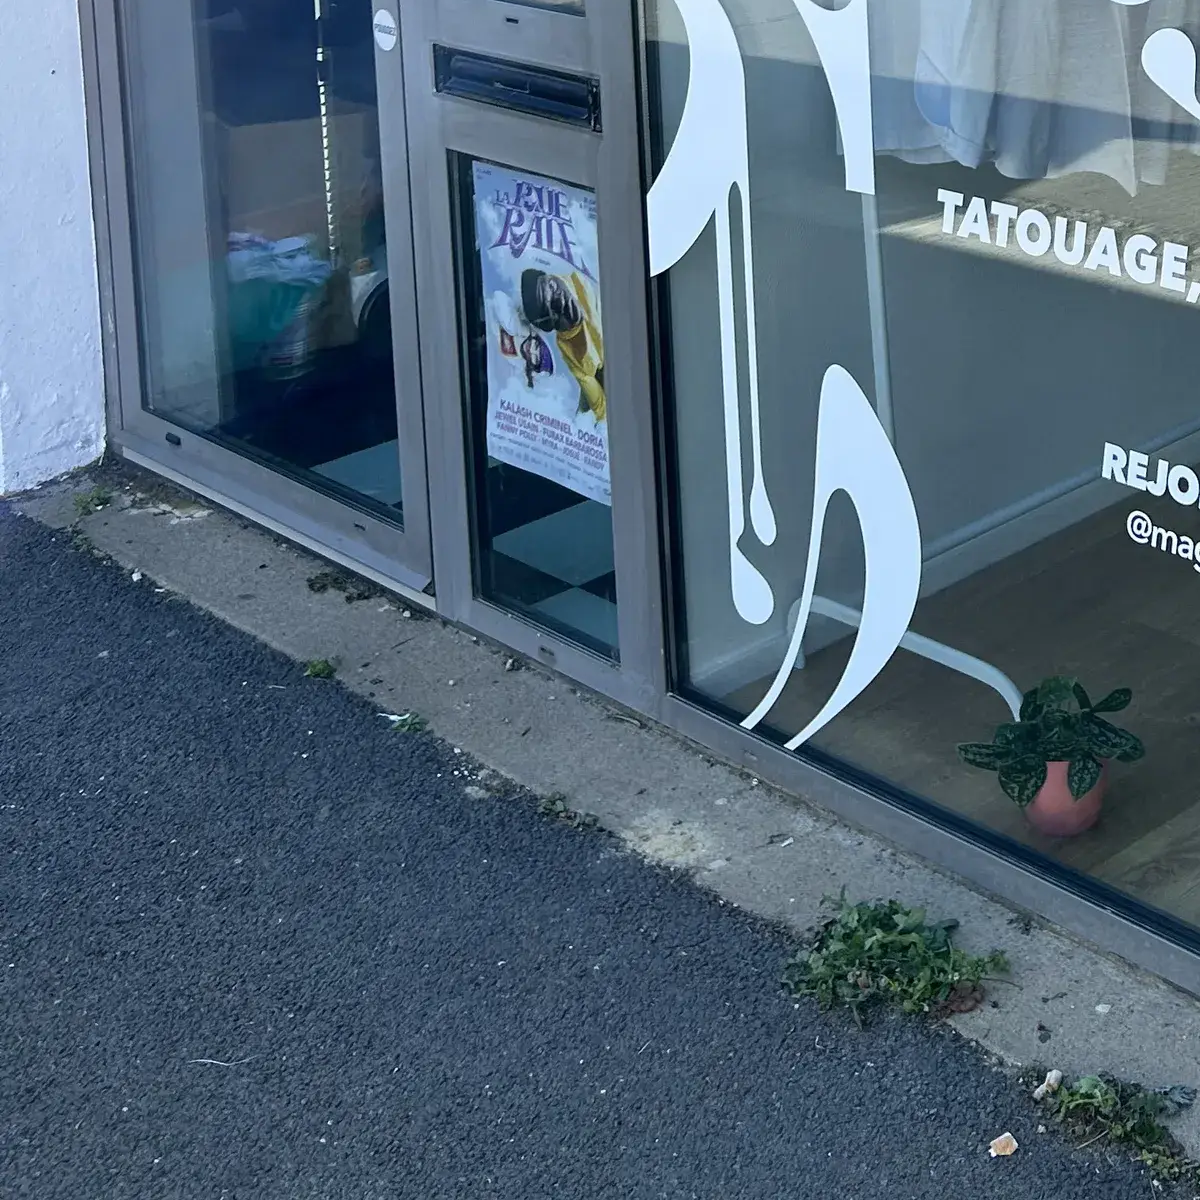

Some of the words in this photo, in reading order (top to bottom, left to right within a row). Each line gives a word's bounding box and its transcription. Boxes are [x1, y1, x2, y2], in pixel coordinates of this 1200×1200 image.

[500, 399, 532, 419] KALASH
[533, 412, 573, 436] CRIMINEL
[578, 429, 604, 449] DORIA
